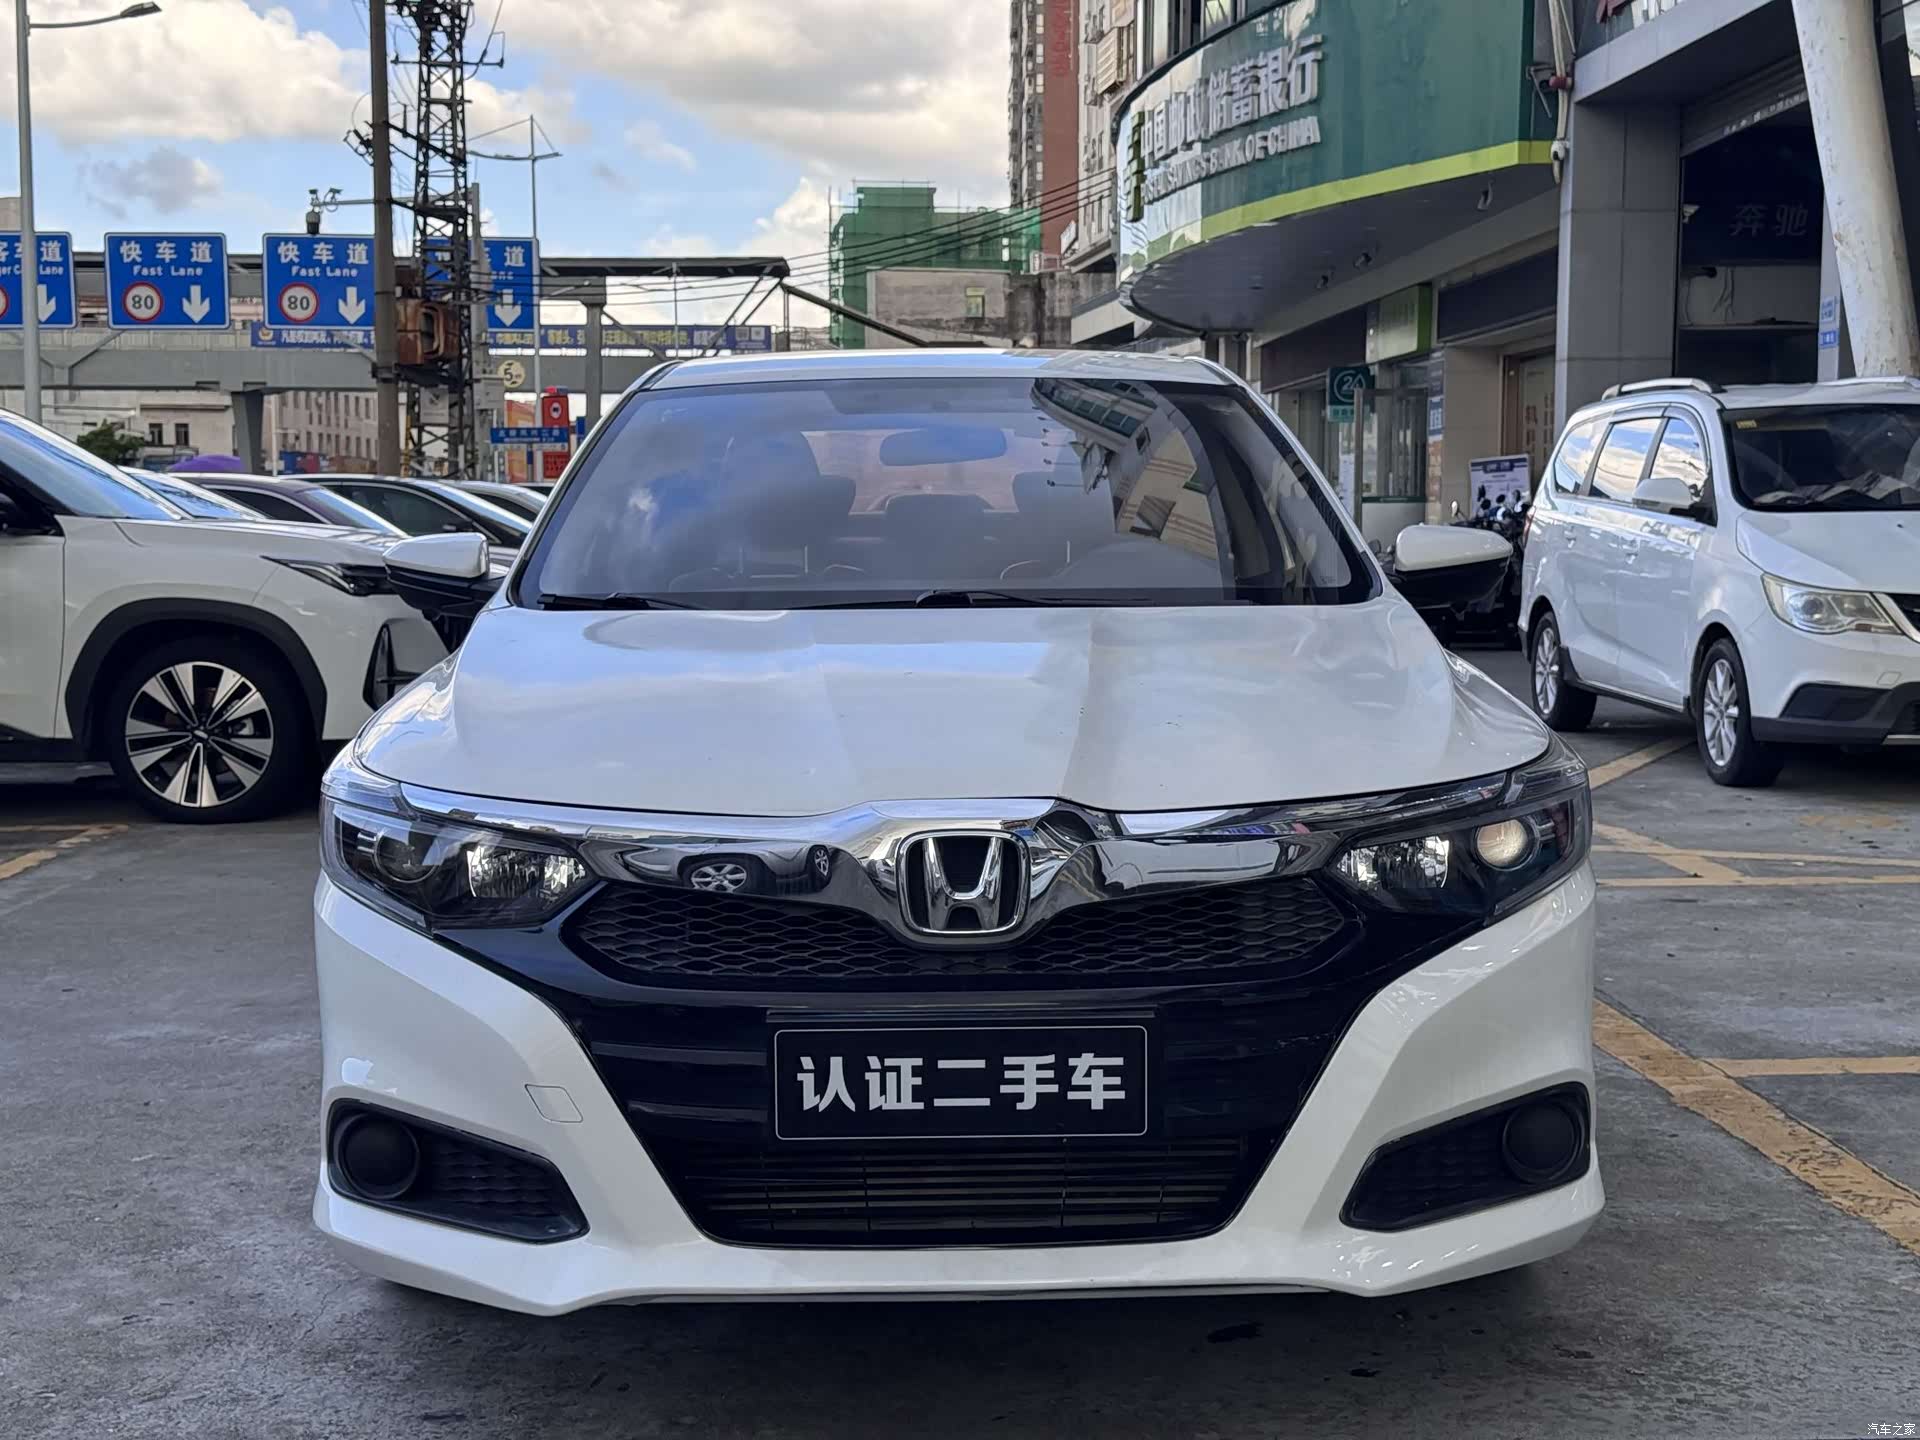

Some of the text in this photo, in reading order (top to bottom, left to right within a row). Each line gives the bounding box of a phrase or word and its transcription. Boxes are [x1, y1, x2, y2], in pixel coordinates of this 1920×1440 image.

[1268, 116, 1321, 155] CHINA
[1727, 202, 1809, 237] 奔驰
[120, 240, 213, 263] 快车道
[277, 241, 369, 264] 快车道
[39, 264, 64, 275] Lane
[133, 265, 203, 276] Fast Lane
[291, 265, 359, 277] Fast Lane
[131, 294, 154, 310] 80
[287, 295, 310, 311] 80
[796, 1052, 1126, 1113] 认证二手车
